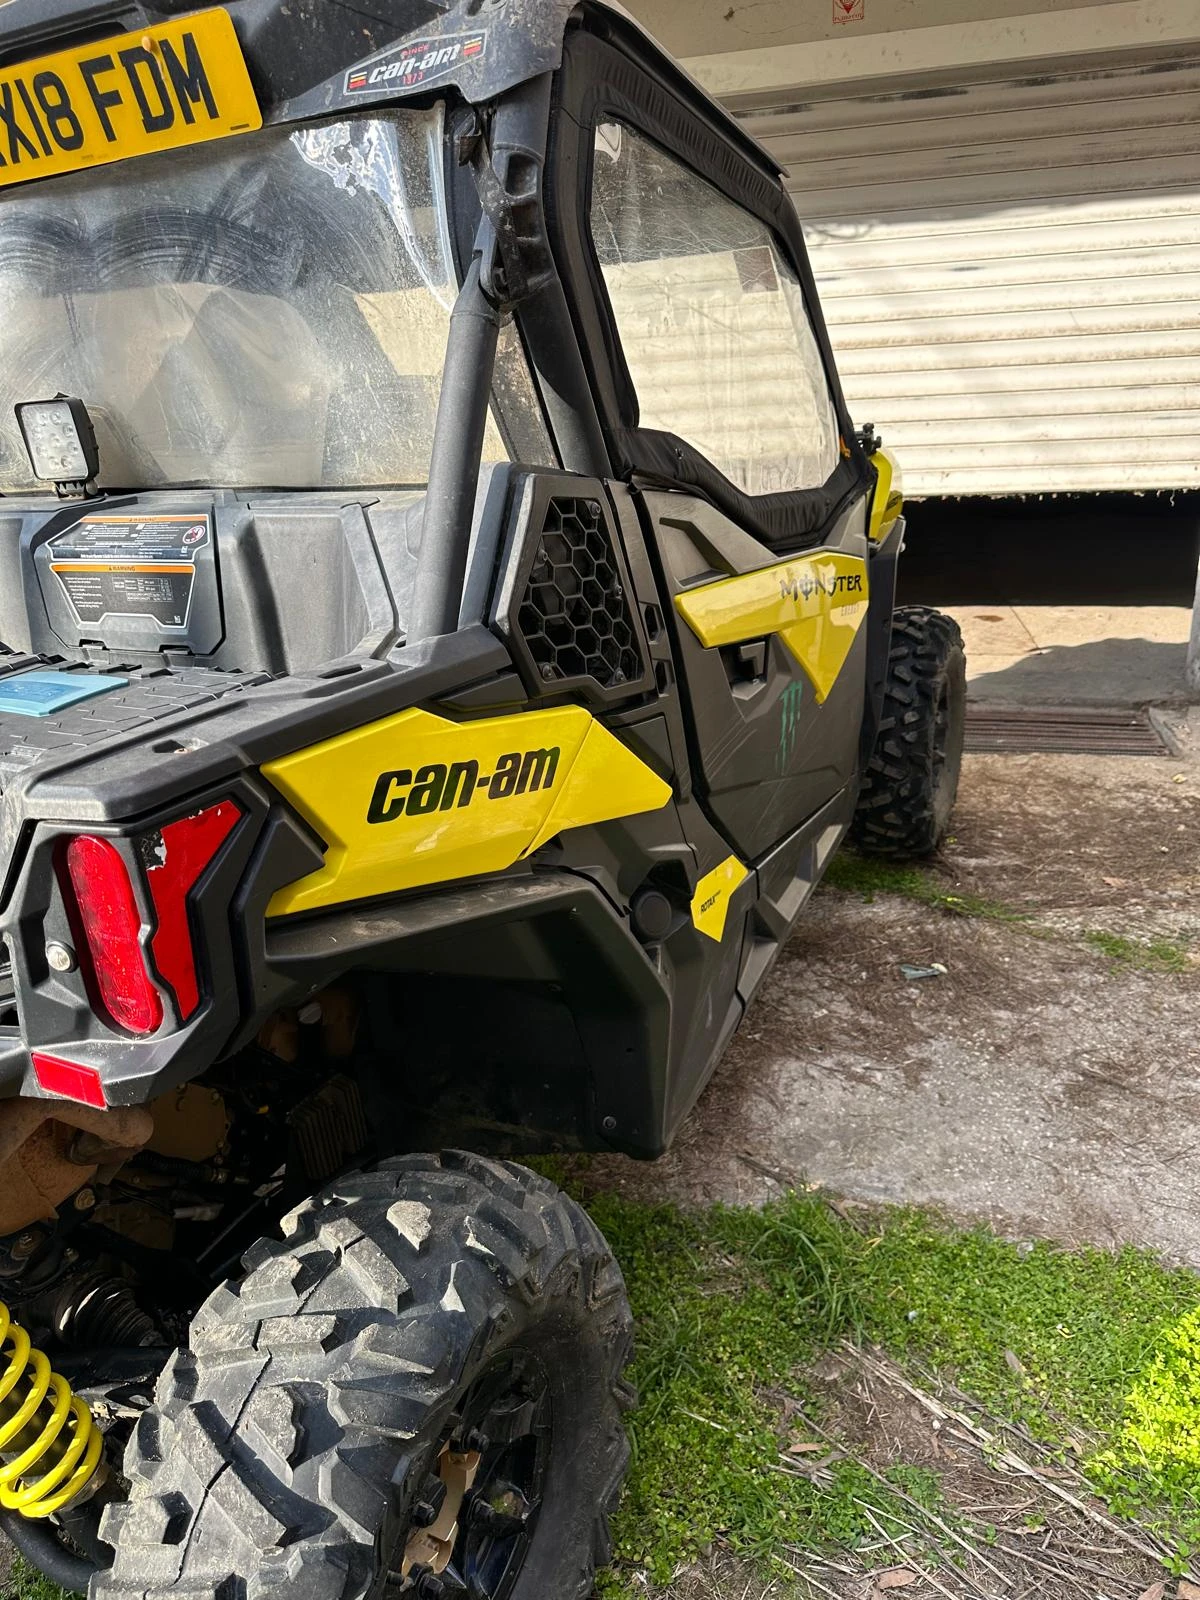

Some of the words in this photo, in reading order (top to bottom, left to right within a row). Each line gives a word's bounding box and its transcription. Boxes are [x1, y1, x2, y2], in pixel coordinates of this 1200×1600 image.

[368, 44, 460, 84] can-am
[0, 71, 84, 168] X18
[78, 32, 220, 142] FDM
[780, 573, 862, 602] MONSTER
[366, 746, 561, 825] can-am
